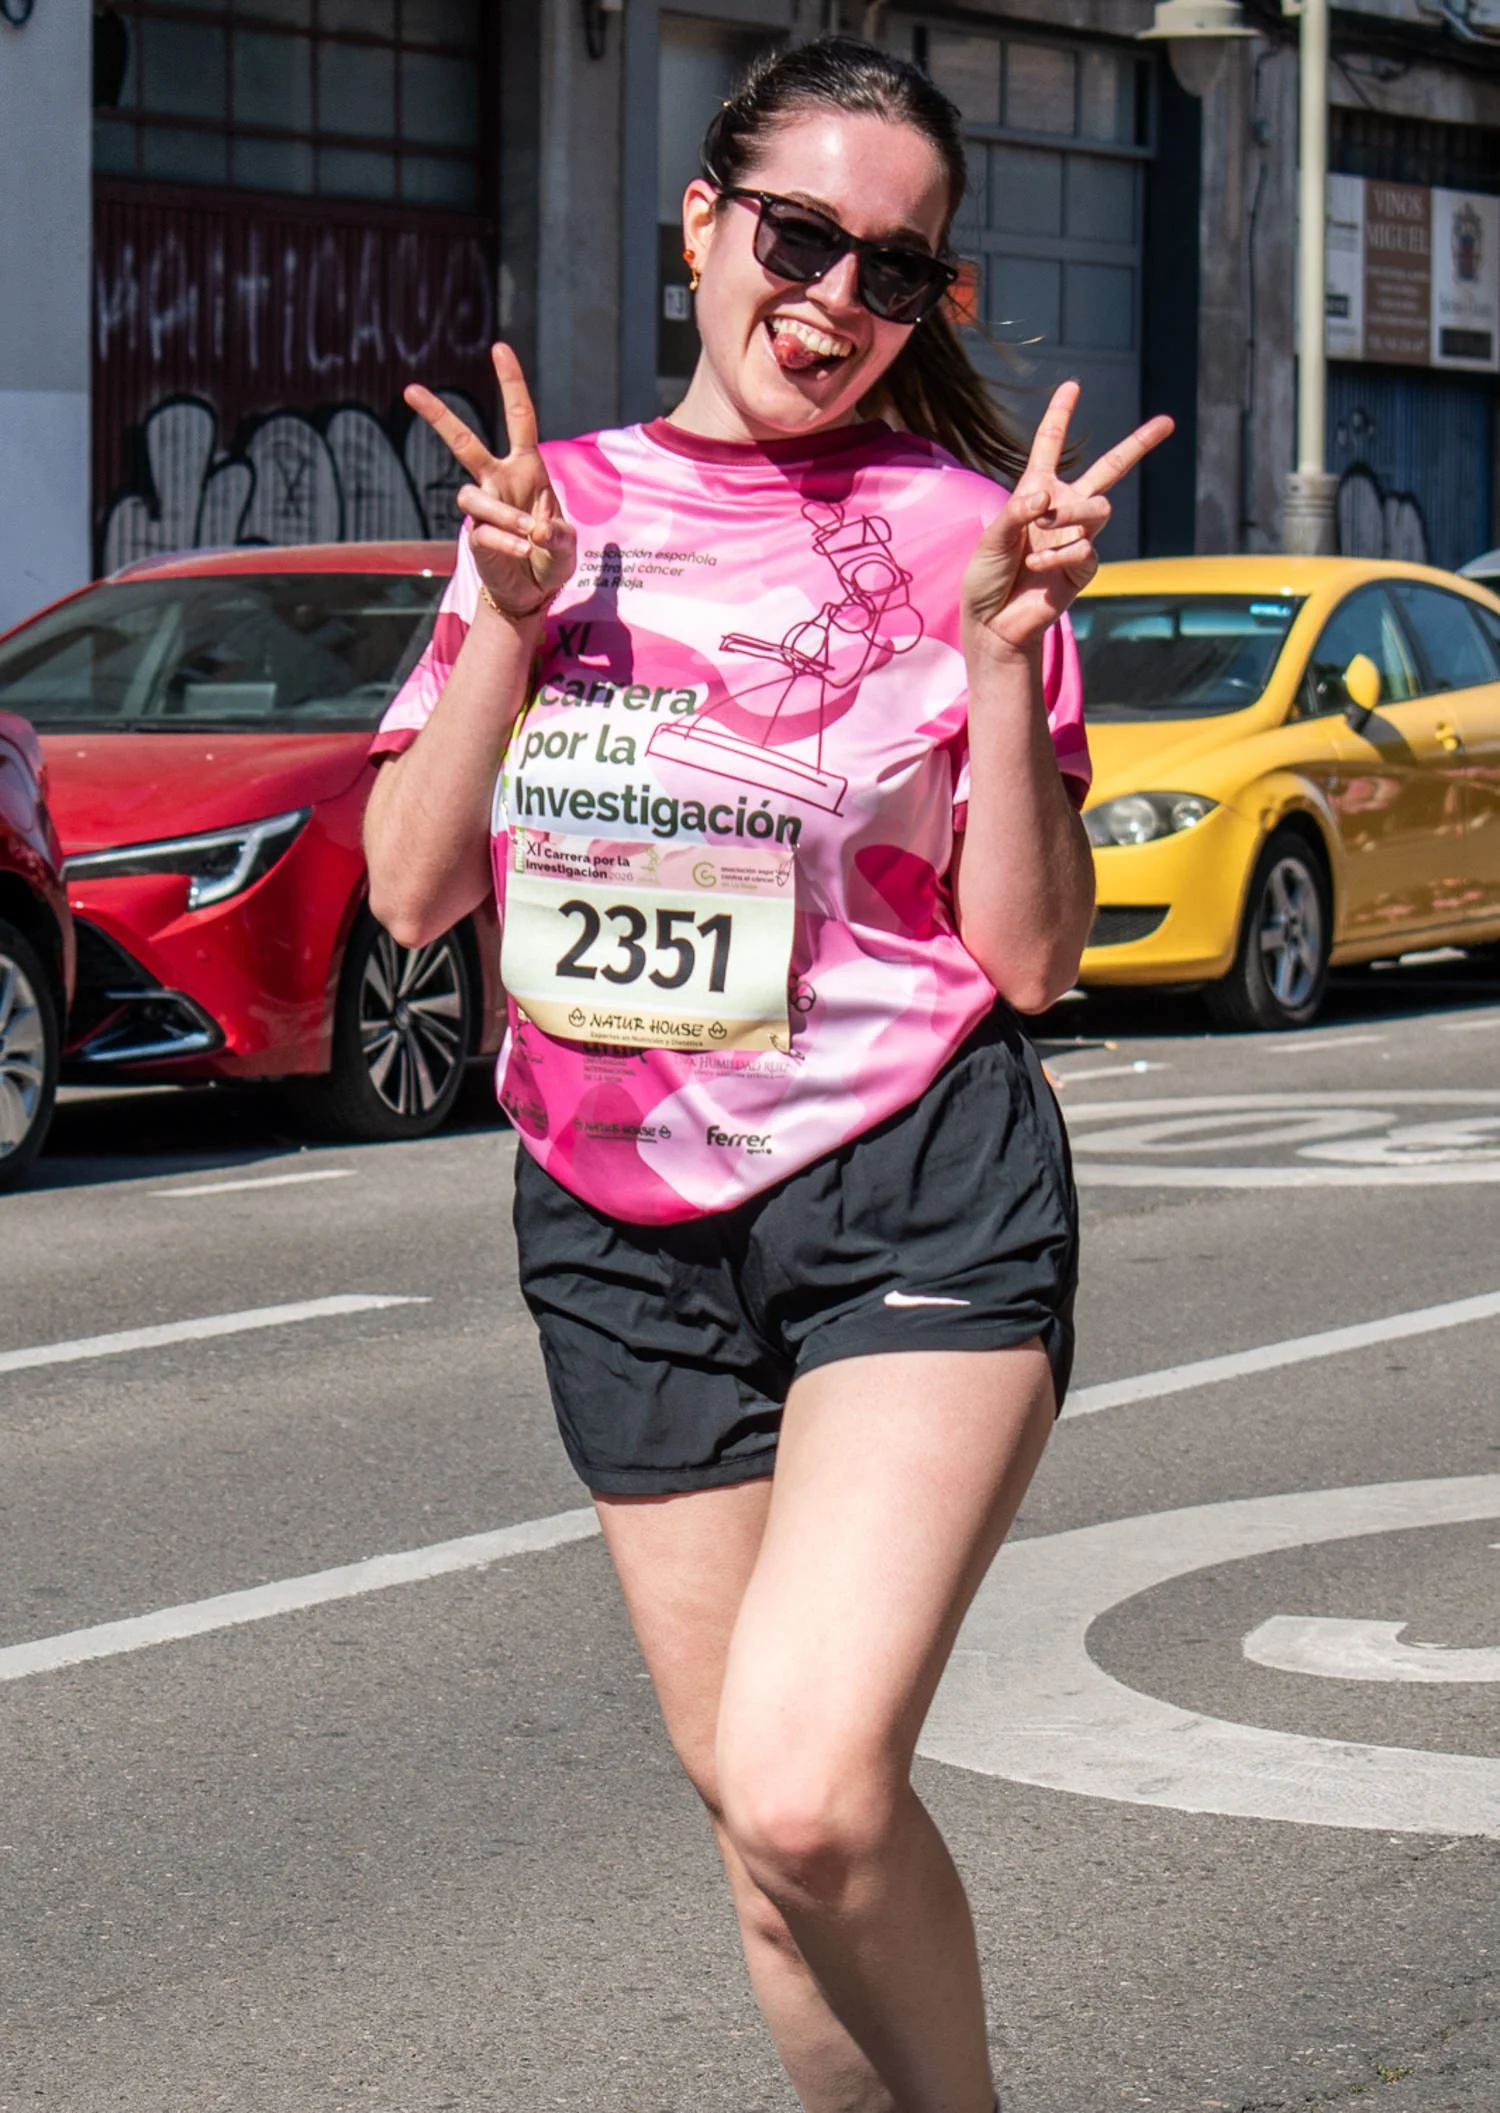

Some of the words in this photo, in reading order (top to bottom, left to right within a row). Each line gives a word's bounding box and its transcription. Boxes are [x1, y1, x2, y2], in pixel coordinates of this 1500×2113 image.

[552, 621, 592, 658] XI
[519, 729, 588, 770] por
[595, 724, 637, 765] la
[515, 776, 802, 846] Investigación
[527, 840, 541, 857] XI
[544, 848, 590, 863] Carrera
[593, 856, 615, 867] por
[617, 856, 630, 867] la
[555, 899, 732, 993] 2351
[590, 1013, 645, 1032] NATUR
[649, 1019, 704, 1037] HOUSE
